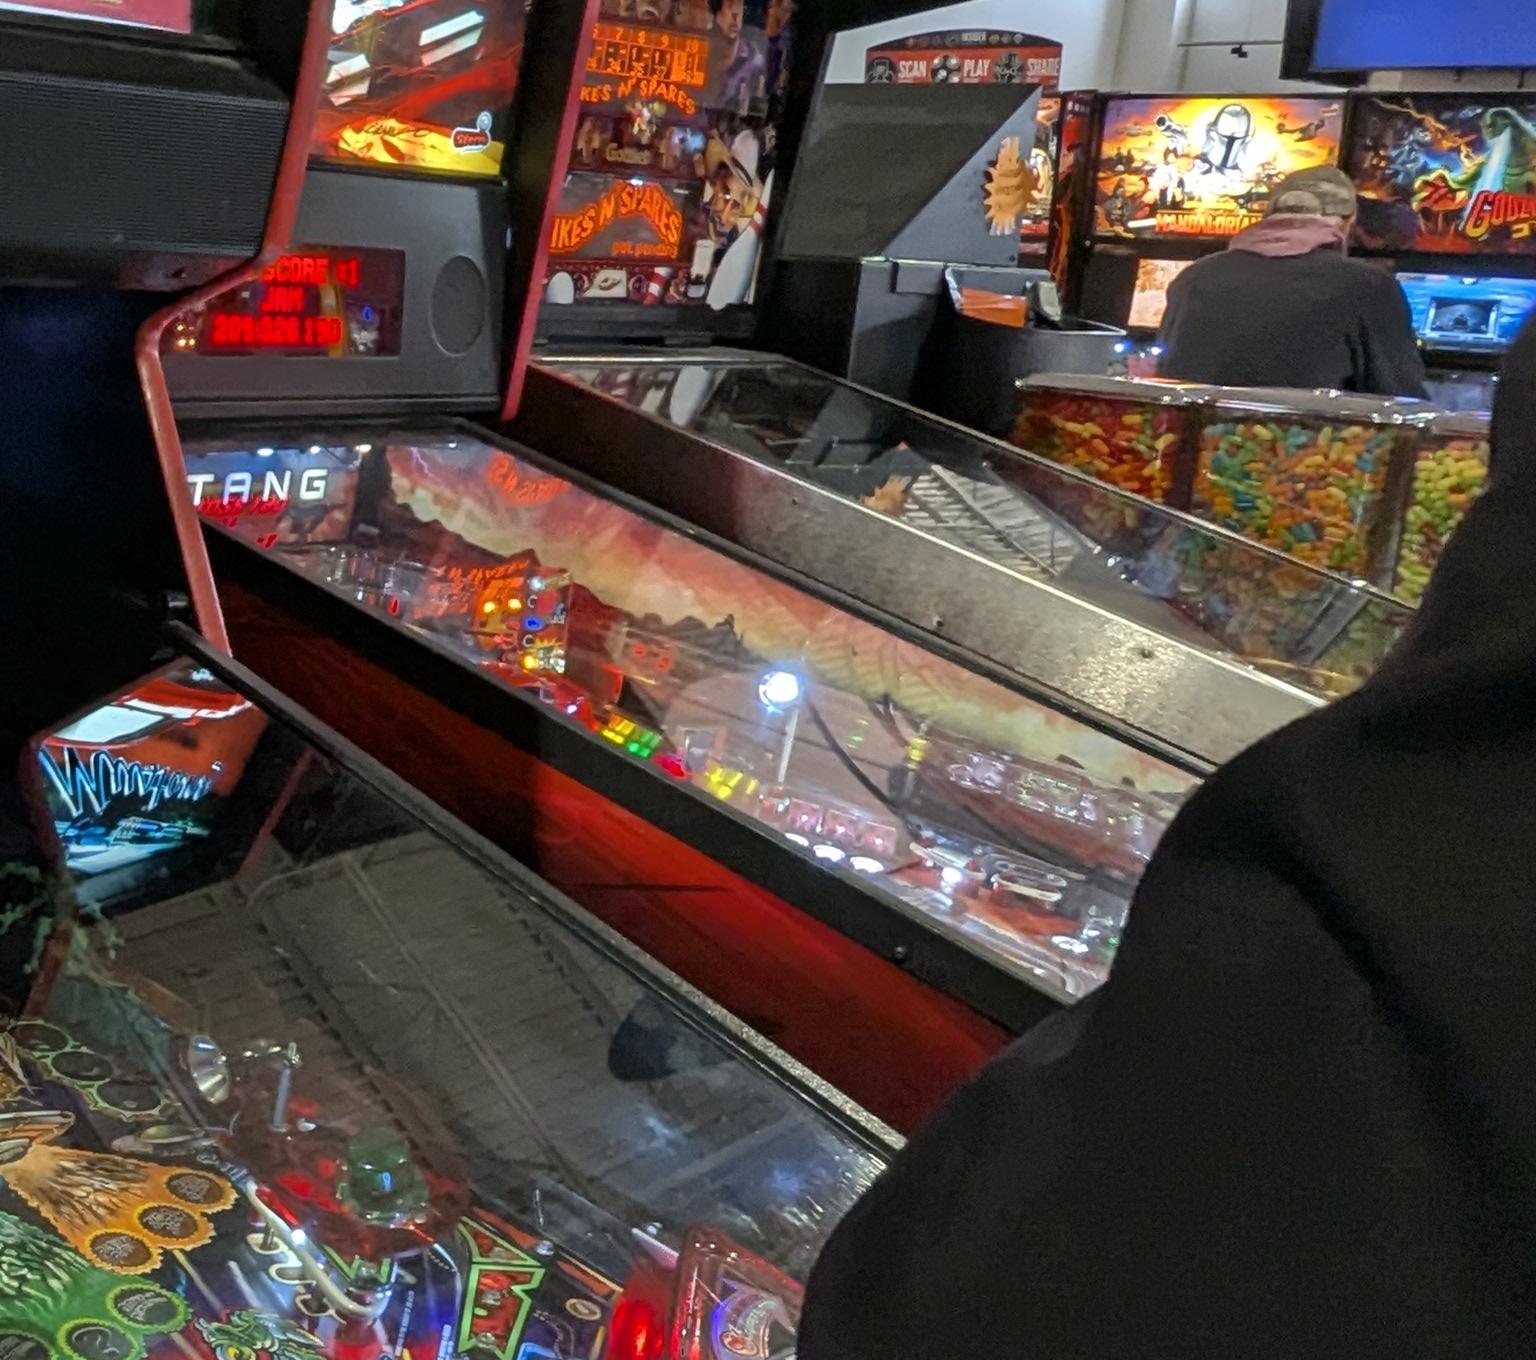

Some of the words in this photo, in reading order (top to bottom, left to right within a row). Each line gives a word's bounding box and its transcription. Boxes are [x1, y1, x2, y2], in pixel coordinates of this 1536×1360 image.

[898, 59, 927, 79] SCAN
[963, 58, 990, 78] PLAY
[638, 79, 699, 117] SPARES
[619, 183, 683, 245] SPARES
[186, 468, 329, 506] TANG
